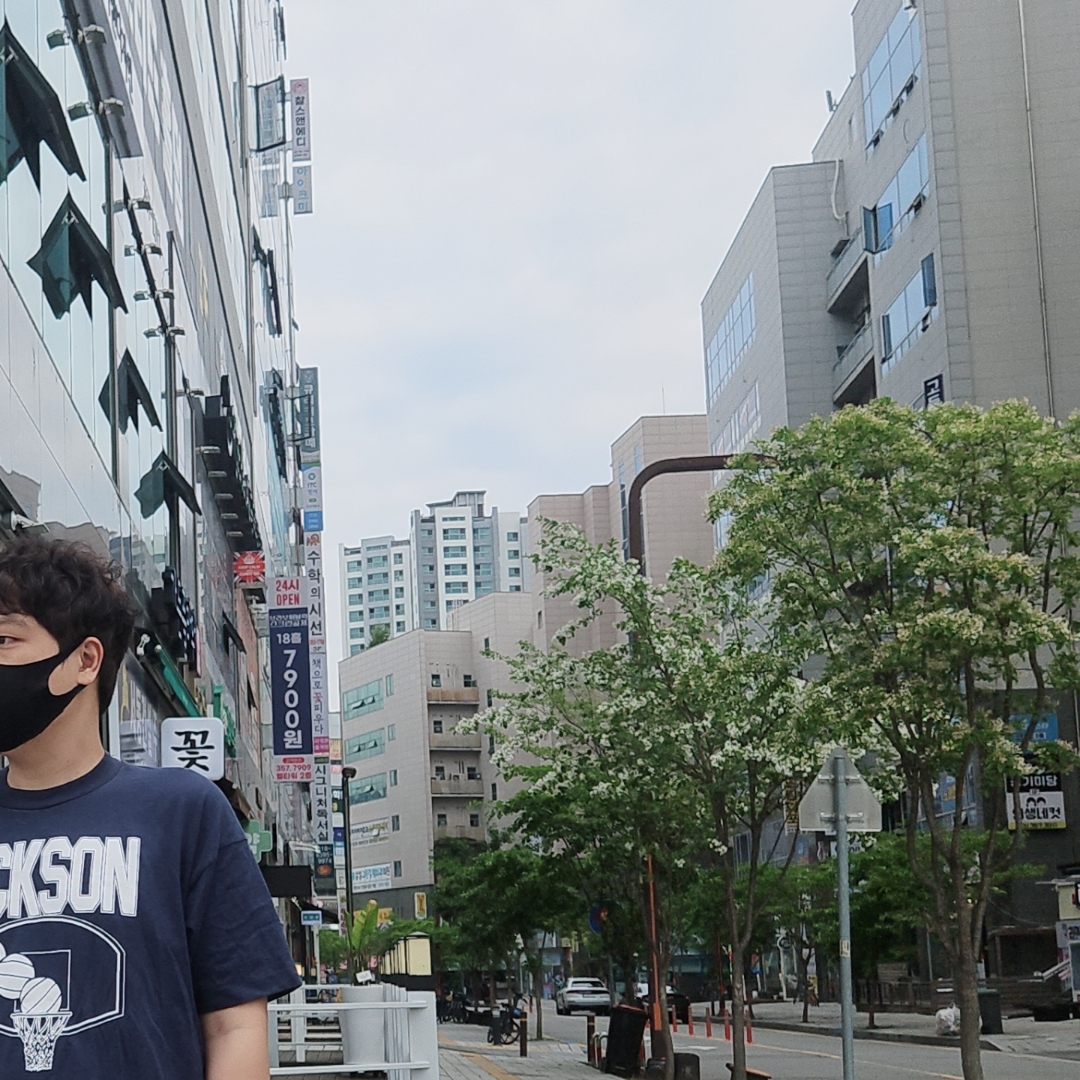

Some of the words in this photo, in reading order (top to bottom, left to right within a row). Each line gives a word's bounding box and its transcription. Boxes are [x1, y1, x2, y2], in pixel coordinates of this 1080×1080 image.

[276, 579, 300, 592] 24시
[276, 594, 300, 606] OPEN
[276, 632, 302, 645] 18홀
[283, 649, 303, 750] 7900원
[170, 730, 215, 772] 꽃
